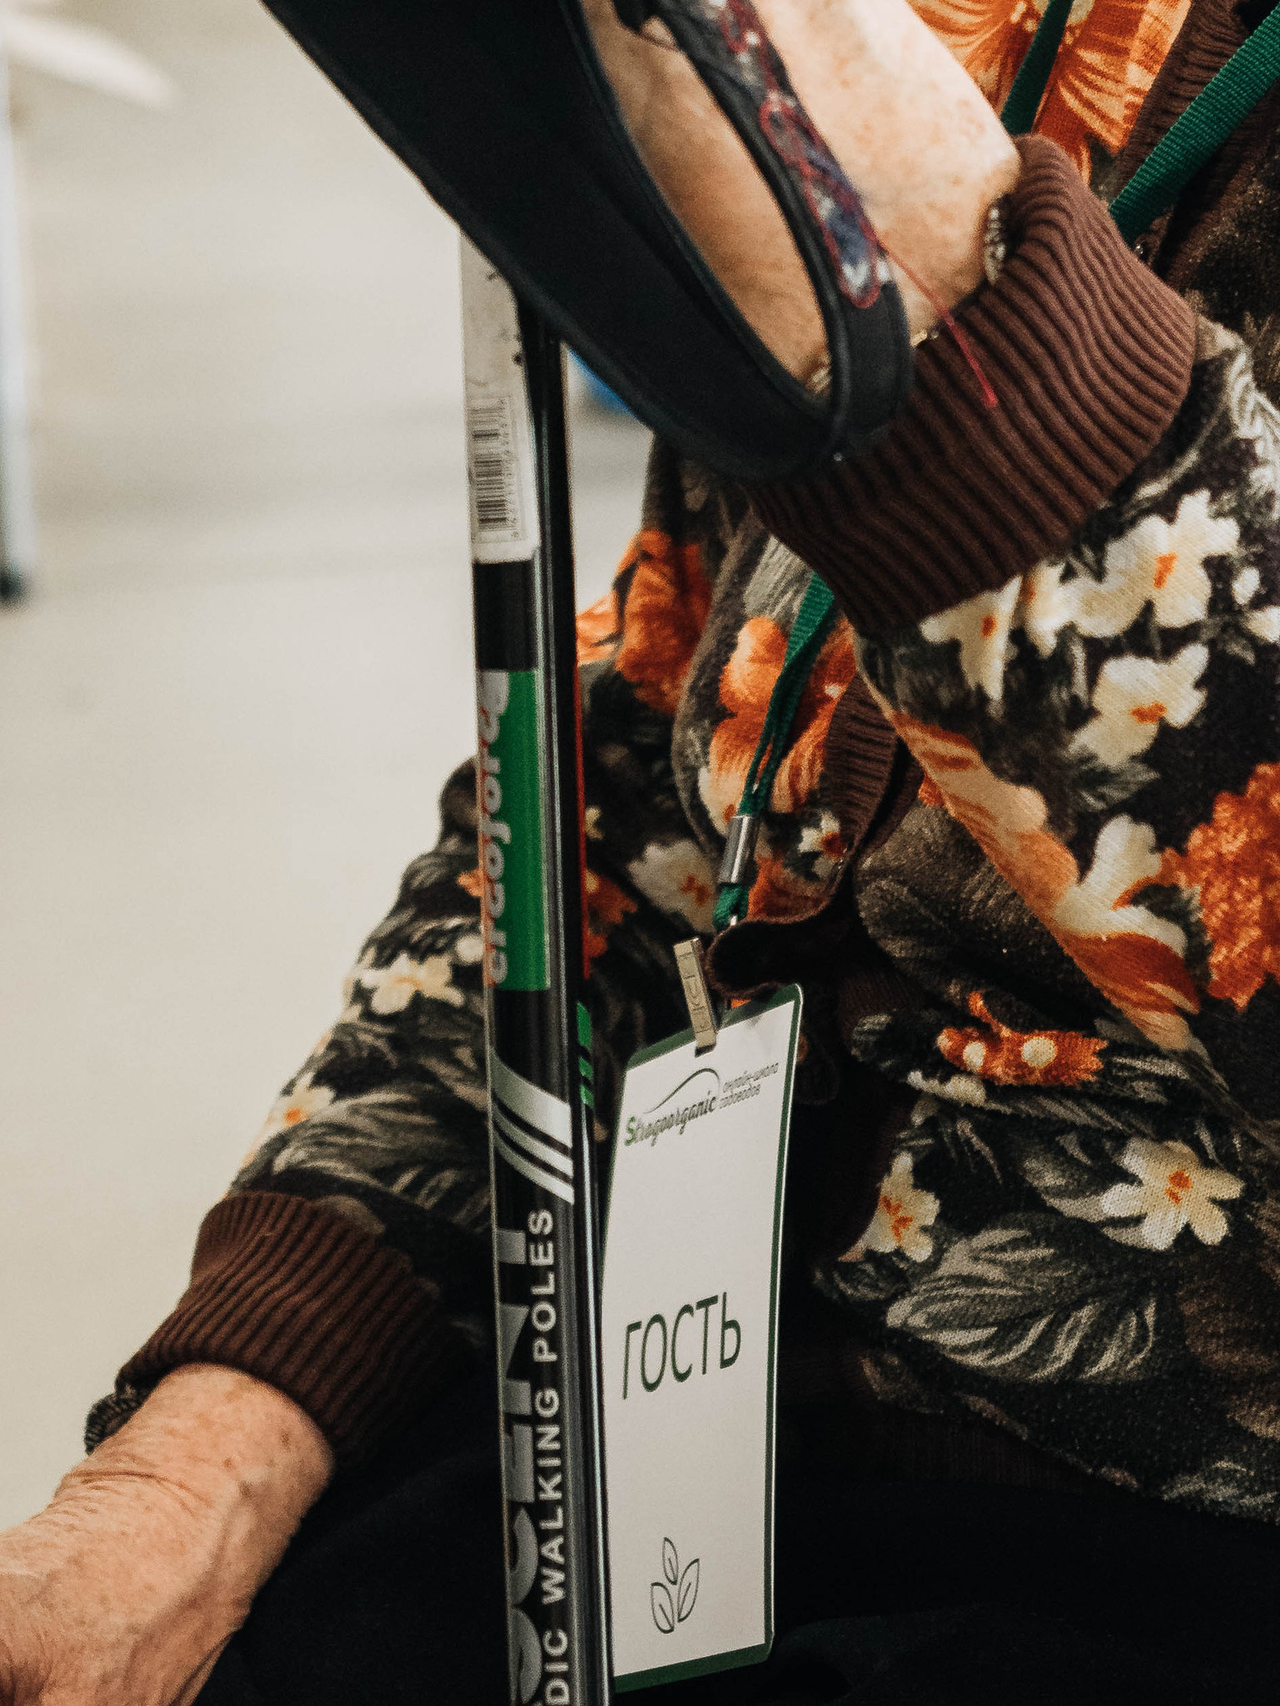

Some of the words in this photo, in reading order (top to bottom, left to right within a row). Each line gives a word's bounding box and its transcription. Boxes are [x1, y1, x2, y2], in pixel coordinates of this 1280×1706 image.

[527, 1208, 559, 1363] POLES
[622, 1291, 741, 1400] ГОСТЬ
[534, 1387, 566, 1605] WALKING
